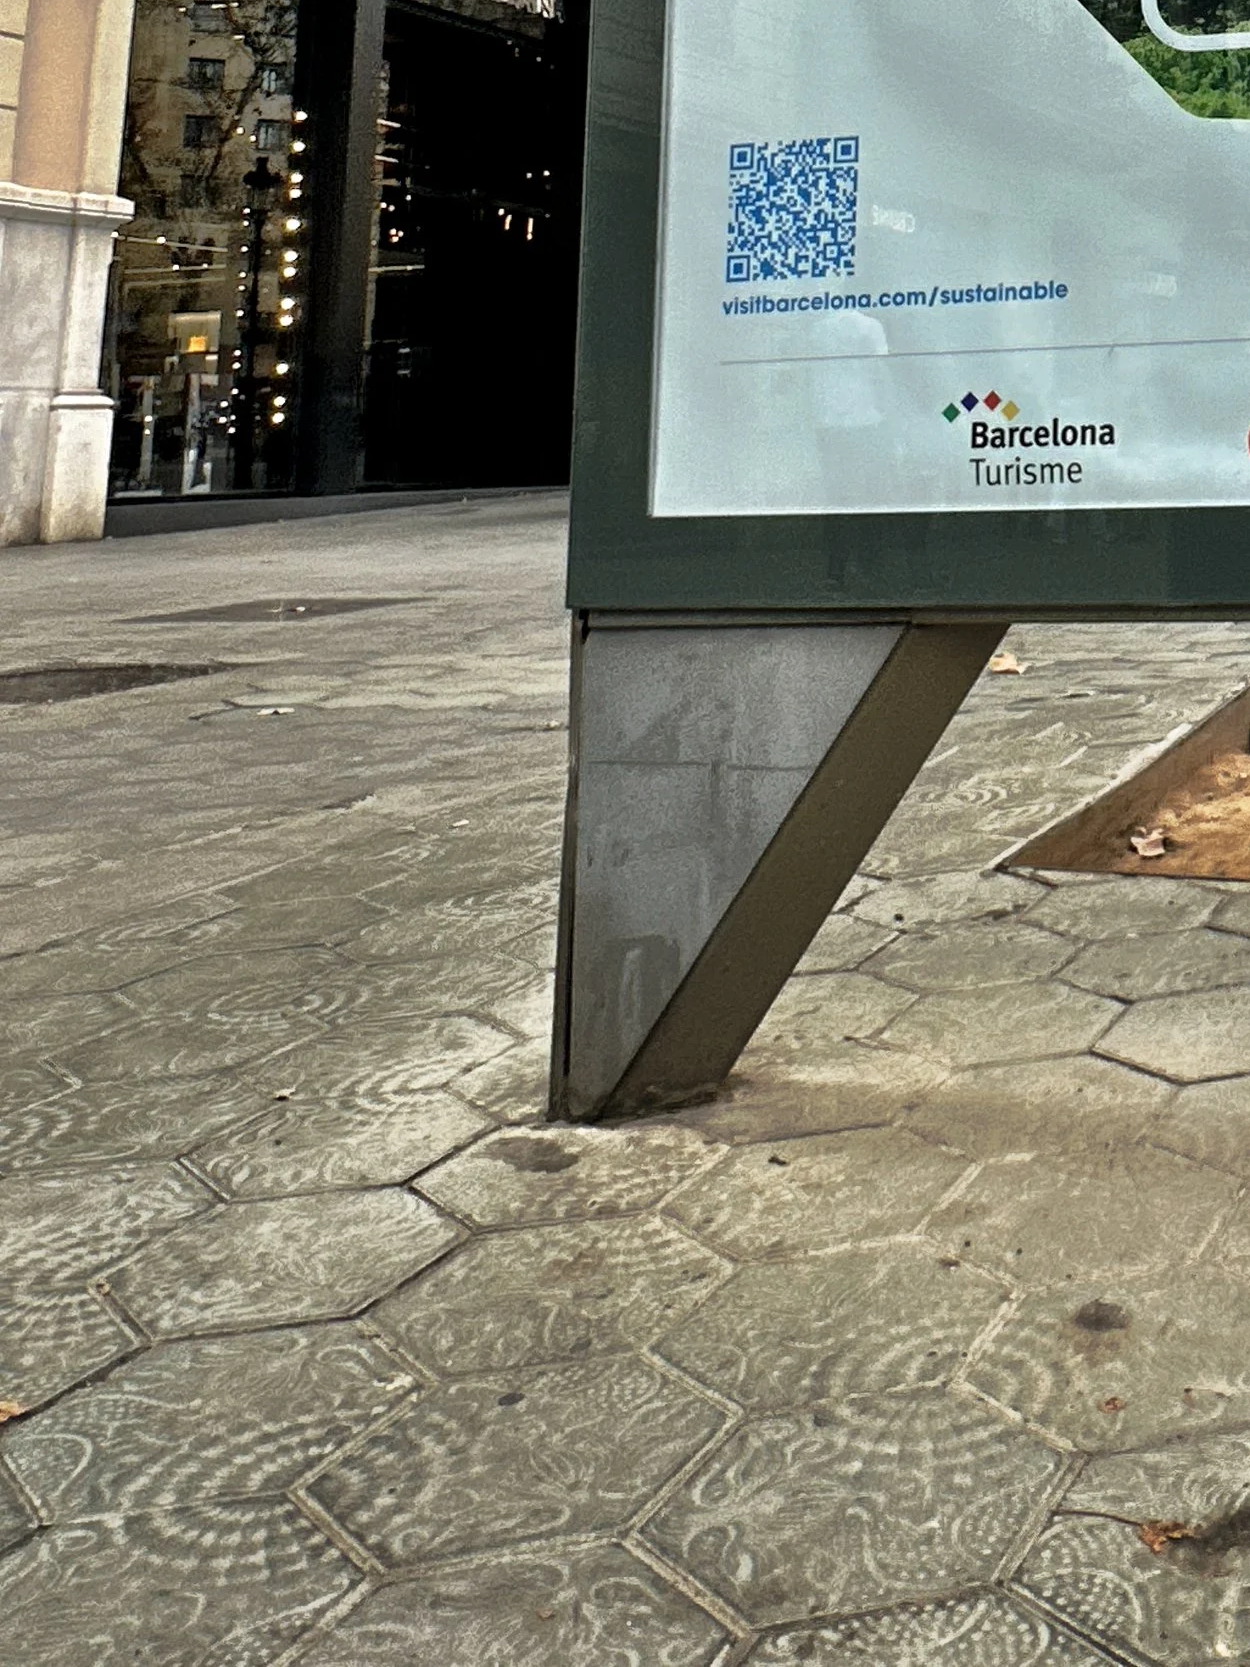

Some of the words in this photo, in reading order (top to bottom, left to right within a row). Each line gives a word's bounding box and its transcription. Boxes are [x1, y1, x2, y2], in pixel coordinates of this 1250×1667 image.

[722, 281, 1069, 315] visitbarcelona.com/sustainable
[971, 418, 1115, 449] Barcelona
[970, 456, 1083, 486] Turisme
